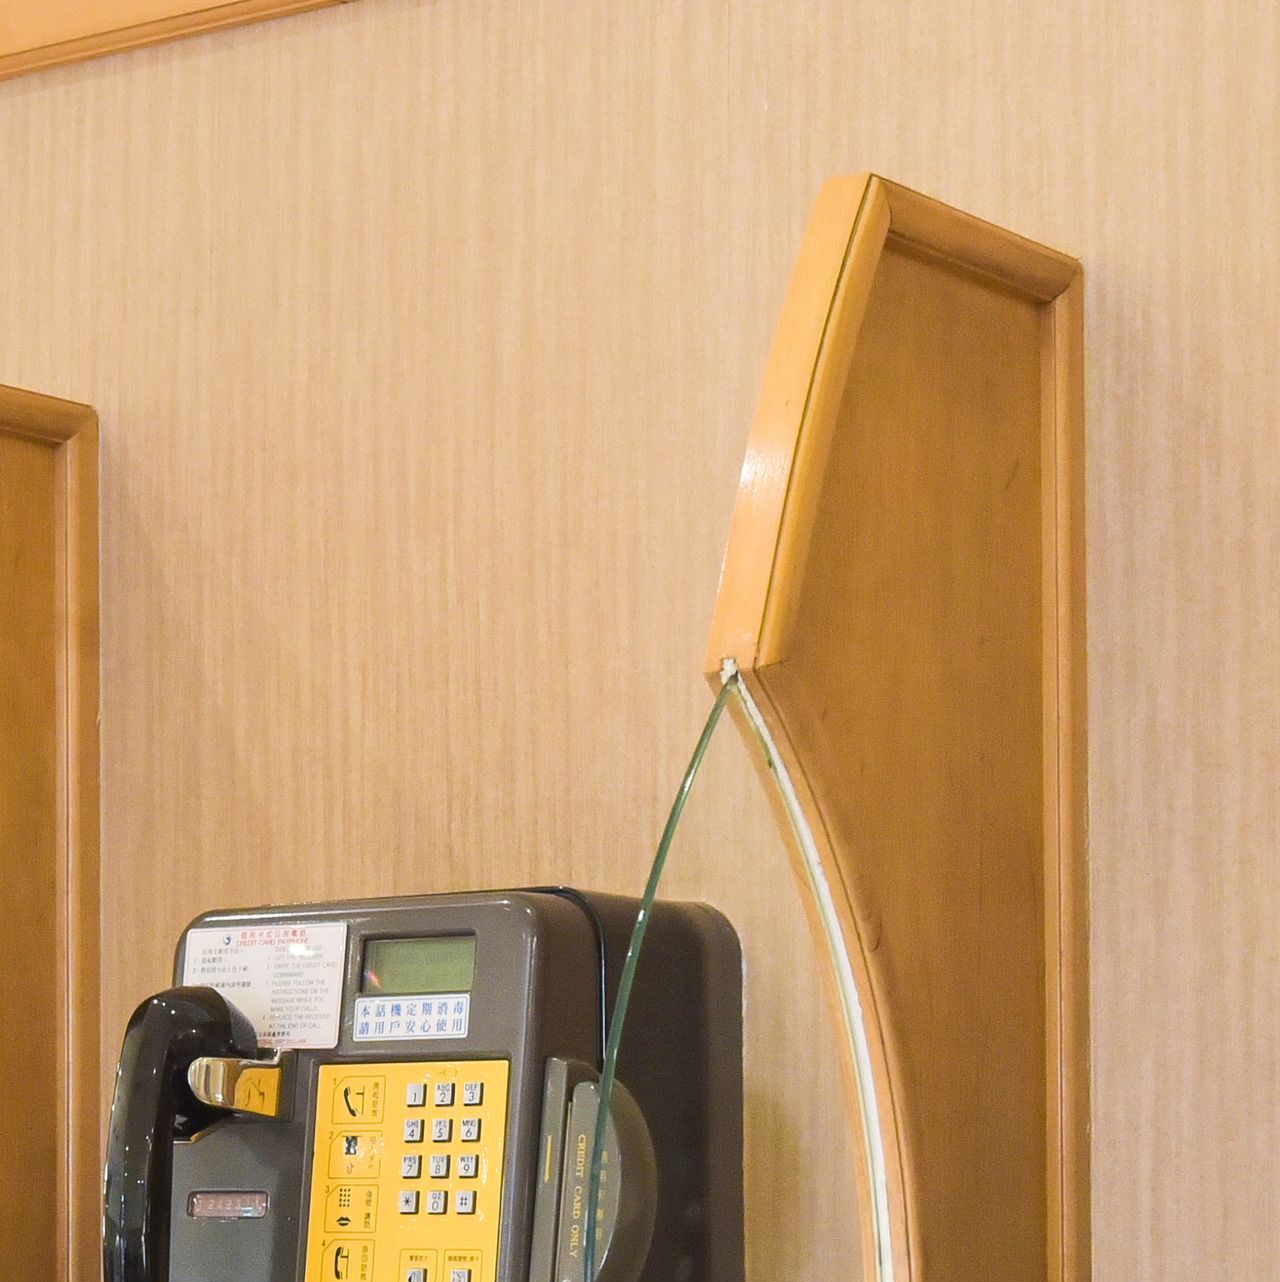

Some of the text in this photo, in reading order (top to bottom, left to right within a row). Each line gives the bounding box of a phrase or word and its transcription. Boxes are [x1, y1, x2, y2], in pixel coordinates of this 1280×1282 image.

[360, 1001, 465, 1018] 本話機定期消毒
[358, 1018, 462, 1035] 請用戶安心使用
[569, 1134, 588, 1259] CREDIT CARD ONLY
